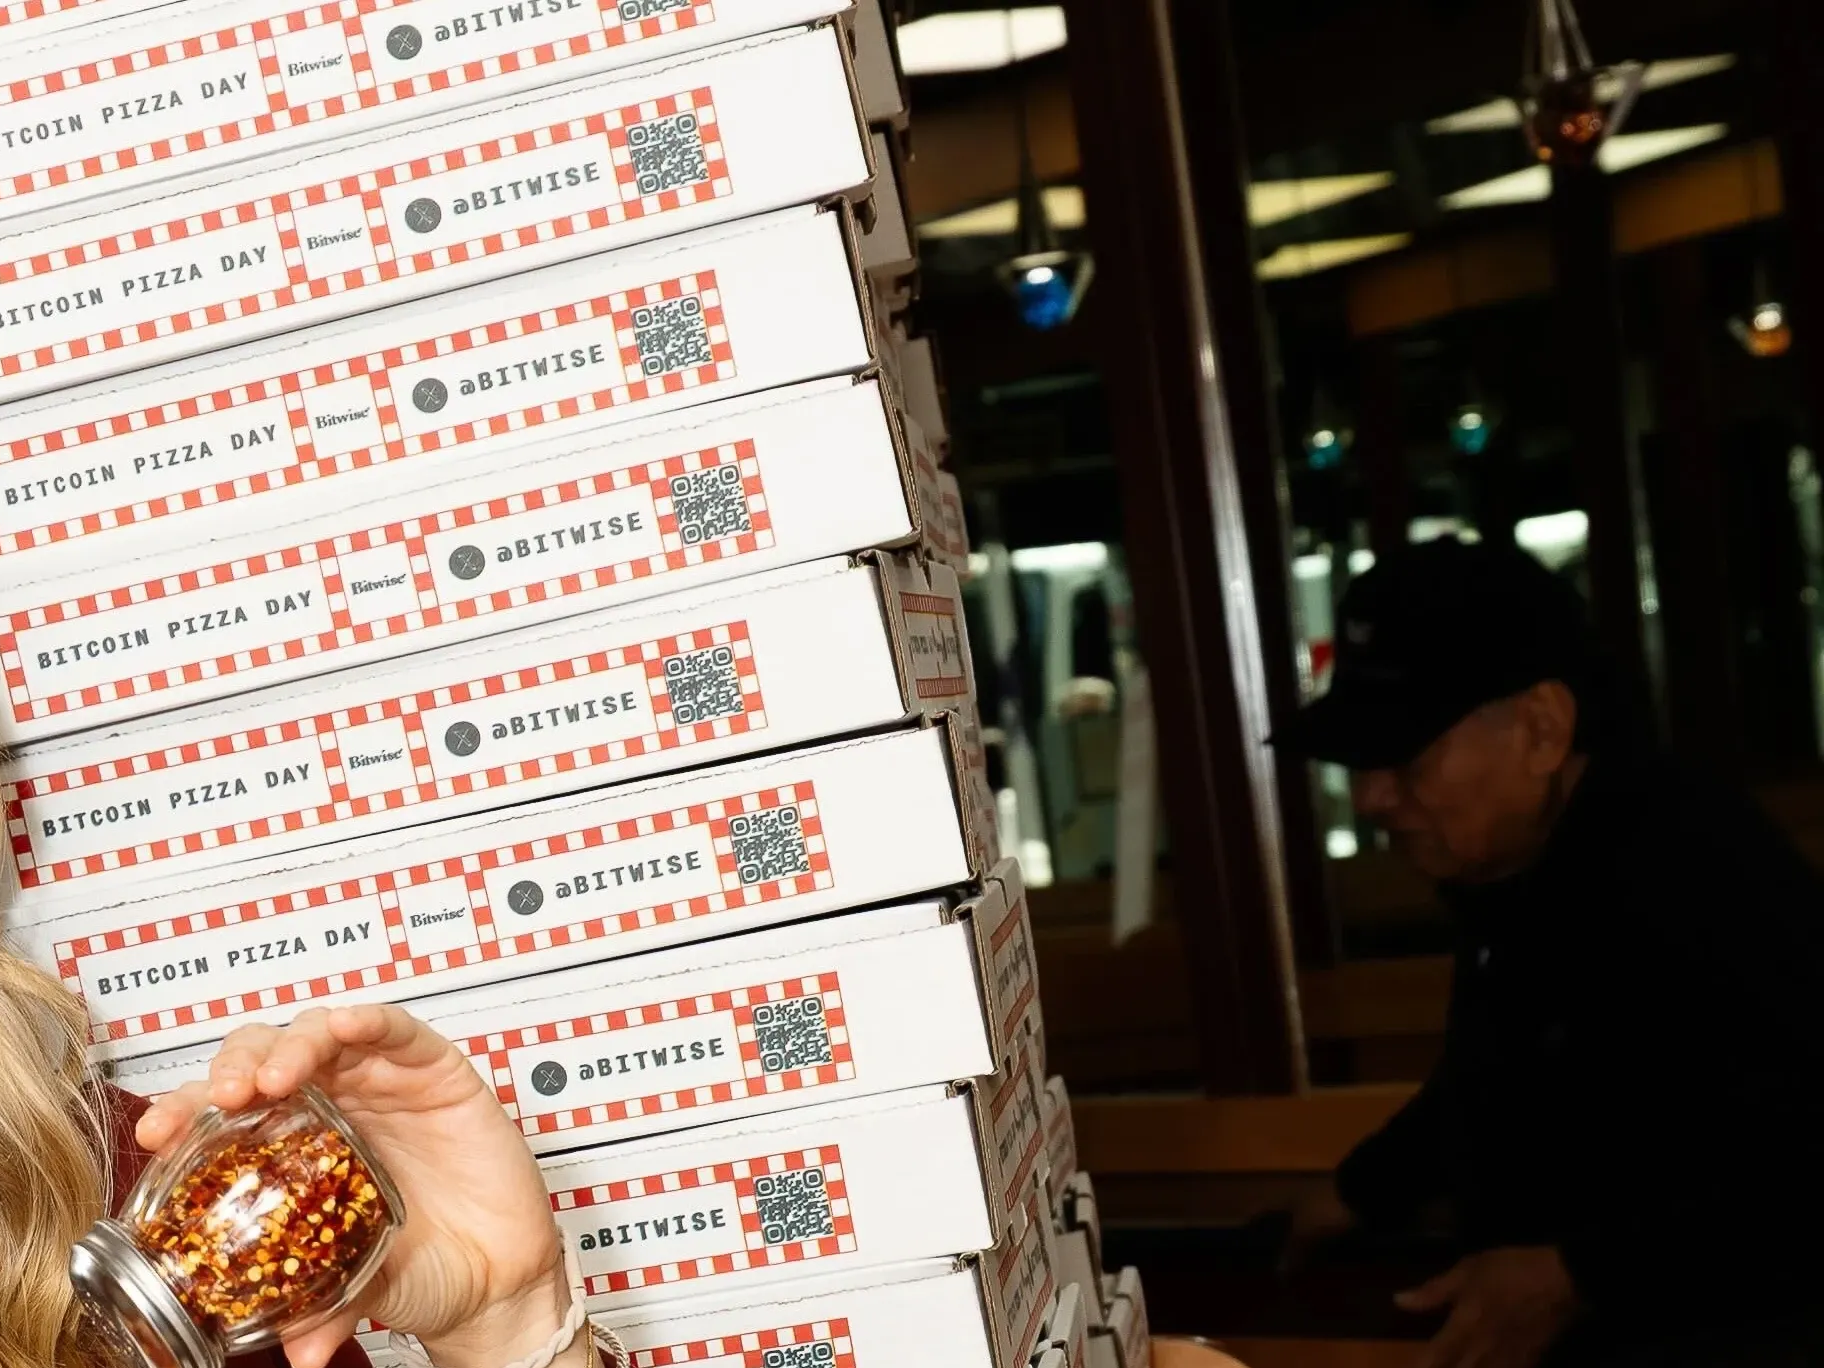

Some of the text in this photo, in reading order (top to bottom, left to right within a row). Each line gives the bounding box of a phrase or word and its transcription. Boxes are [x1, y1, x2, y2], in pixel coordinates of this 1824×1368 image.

[288, 54, 343, 77] Bitwise
[102, 91, 182, 123] PIZZA
[201, 73, 248, 98] DAY
[453, 162, 601, 214] @BITWISE
[306, 227, 362, 250] Bitwise
[122, 264, 202, 296] PIZZA
[221, 246, 267, 272] DAY
[460, 344, 605, 396] @BITWISE
[315, 406, 370, 430] Bitwise
[5, 425, 277, 505] BITCOIN PIZZA DAY
[497, 511, 643, 562] @BITWISE
[351, 573, 406, 596] Bitwise
[38, 590, 312, 669] BITCOIN PIZZA DAY
[492, 692, 637, 740] @BITWISE
[349, 748, 404, 770] Bitwise
[43, 764, 311, 839] BITCOIN PIZZA DAY
[555, 850, 702, 899] @BITWISE
[410, 906, 465, 929] Bitwise
[98, 922, 371, 995] BITCOIN PIZZA DAY
[579, 1038, 725, 1081] @BITWISE
[580, 1209, 726, 1251] @BITWISE
